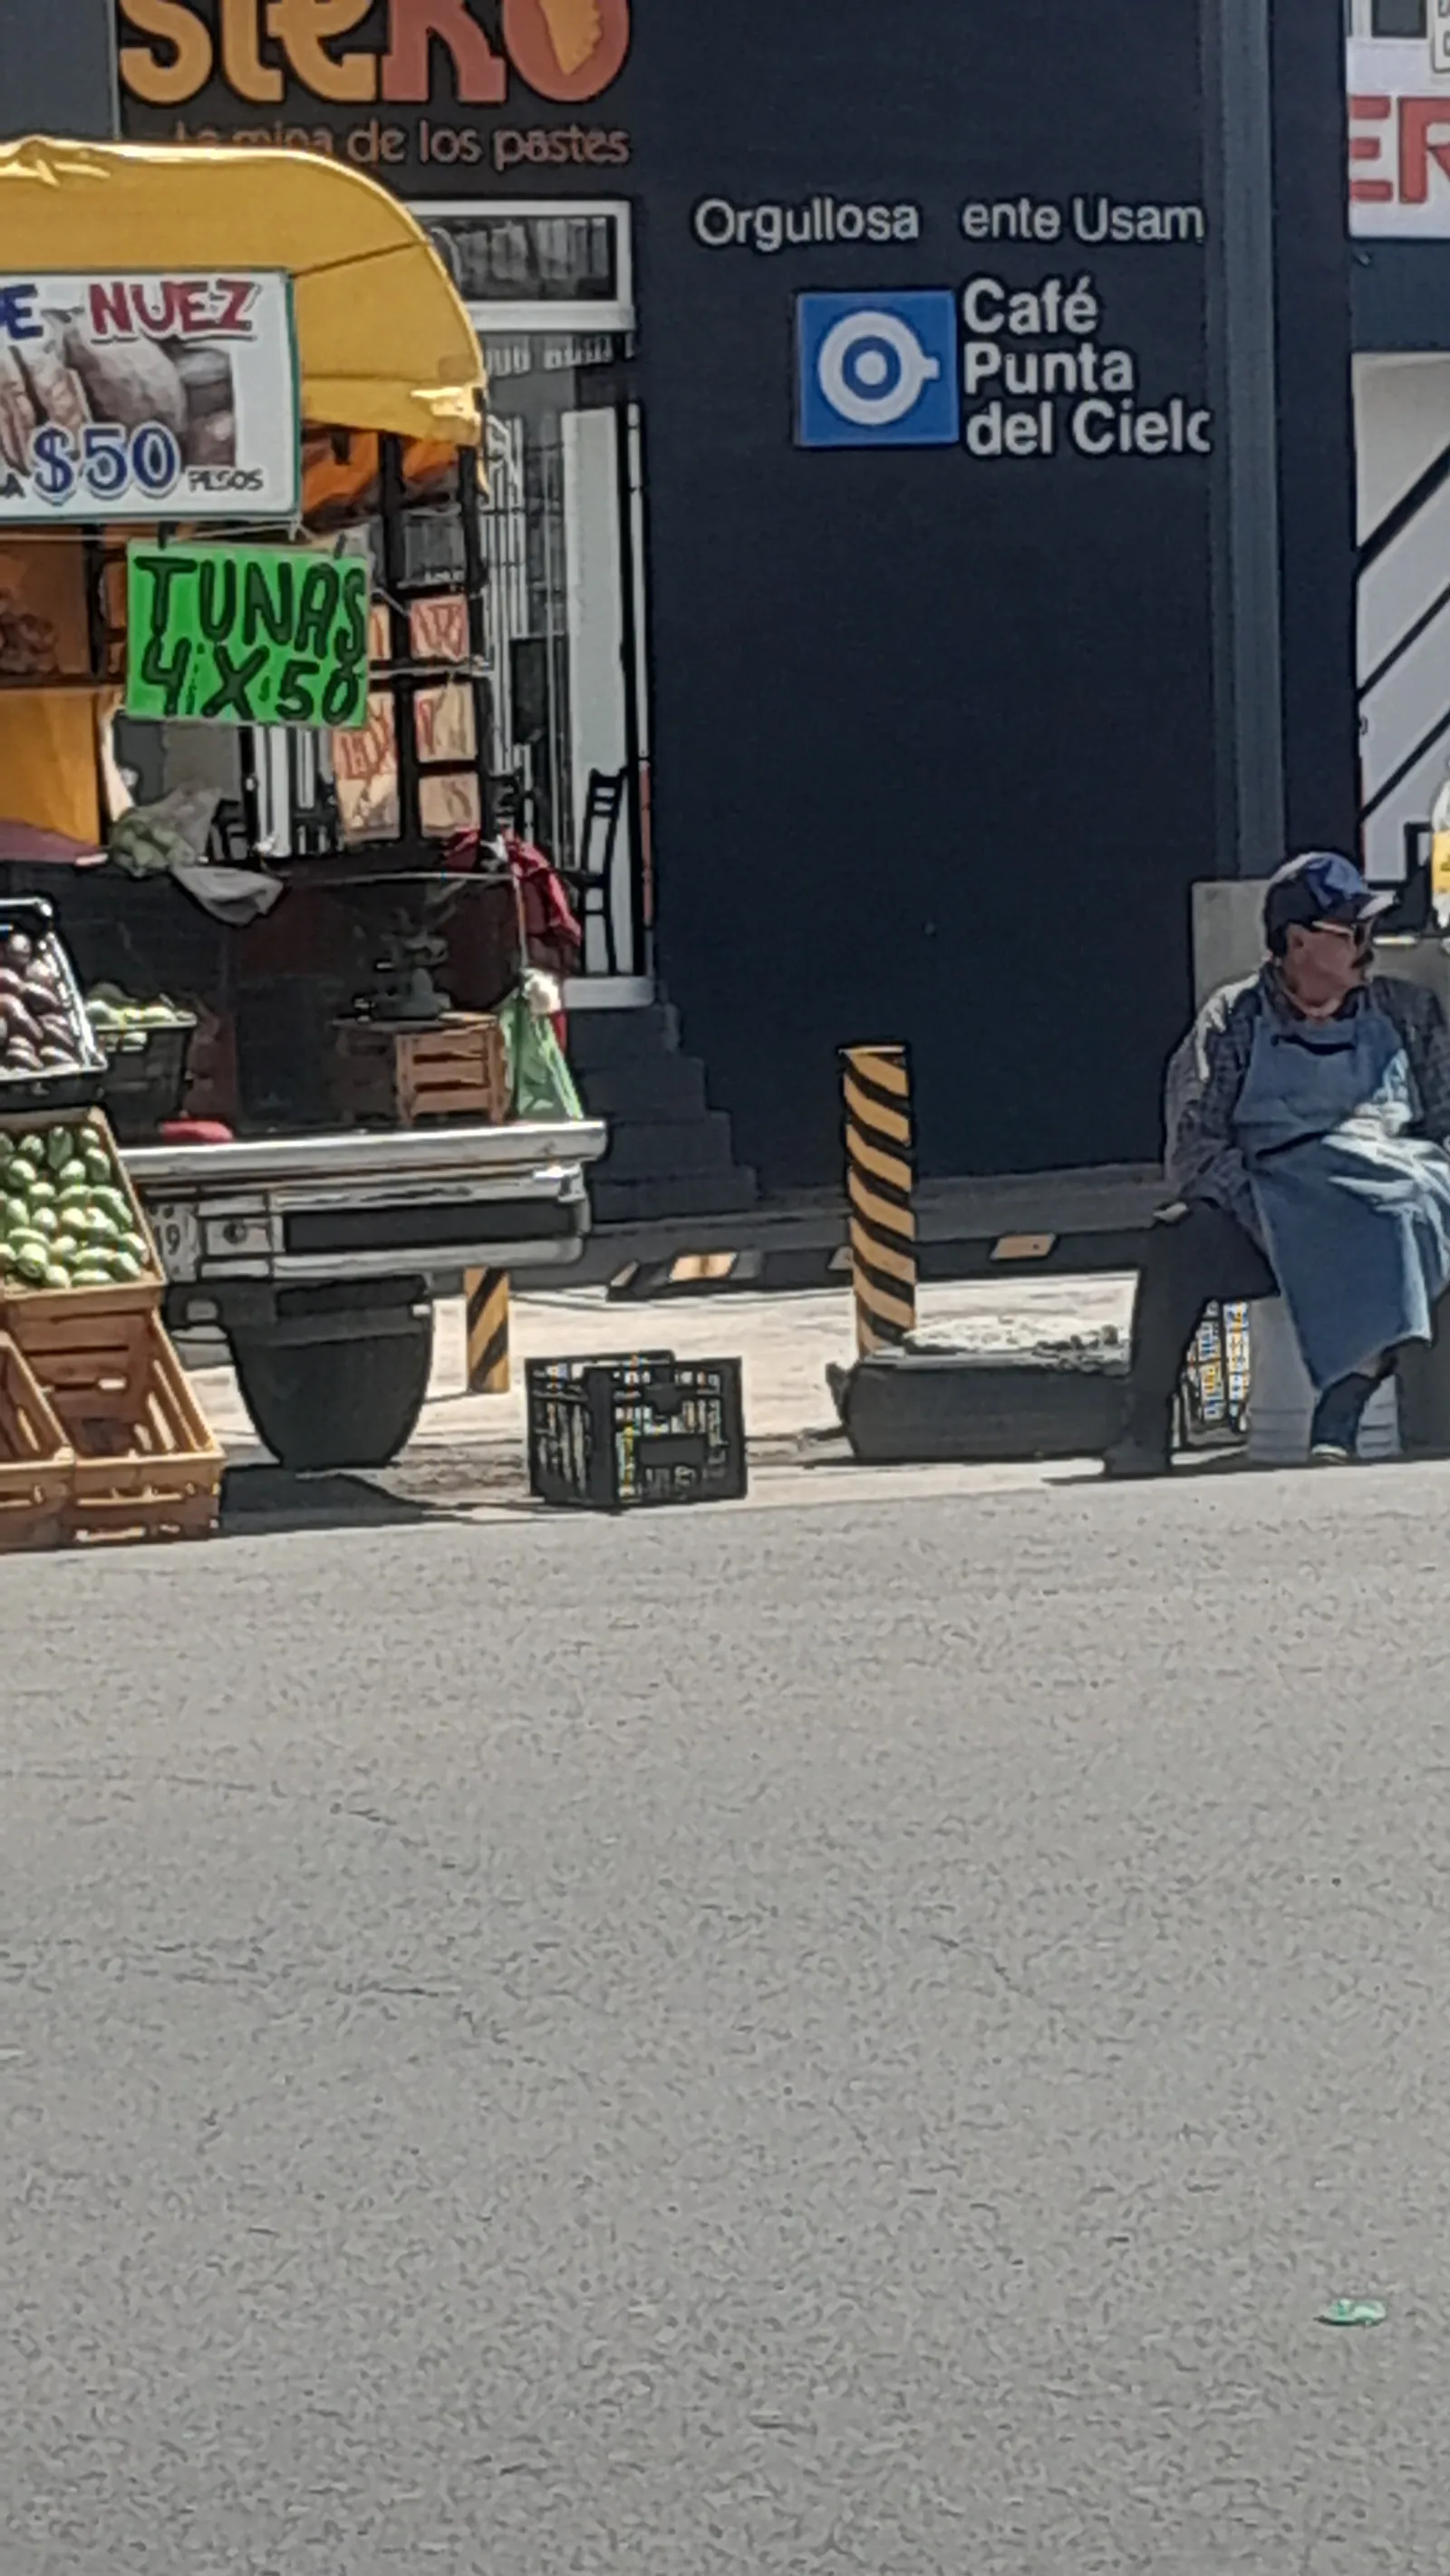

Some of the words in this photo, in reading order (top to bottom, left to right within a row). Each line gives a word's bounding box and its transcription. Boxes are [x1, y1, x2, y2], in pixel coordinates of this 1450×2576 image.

[346, 117, 406, 163] de
[420, 119, 484, 163] los
[494, 124, 631, 171] pastes
[0, 283, 44, 339] E
[88, 278, 257, 336] NUEZ
[962, 275, 1099, 334] Café
[963, 342, 1135, 395] Punta
[966, 400, 1054, 455] del
[34, 426, 177, 495] $50
[133, 555, 367, 664] TUNAS
